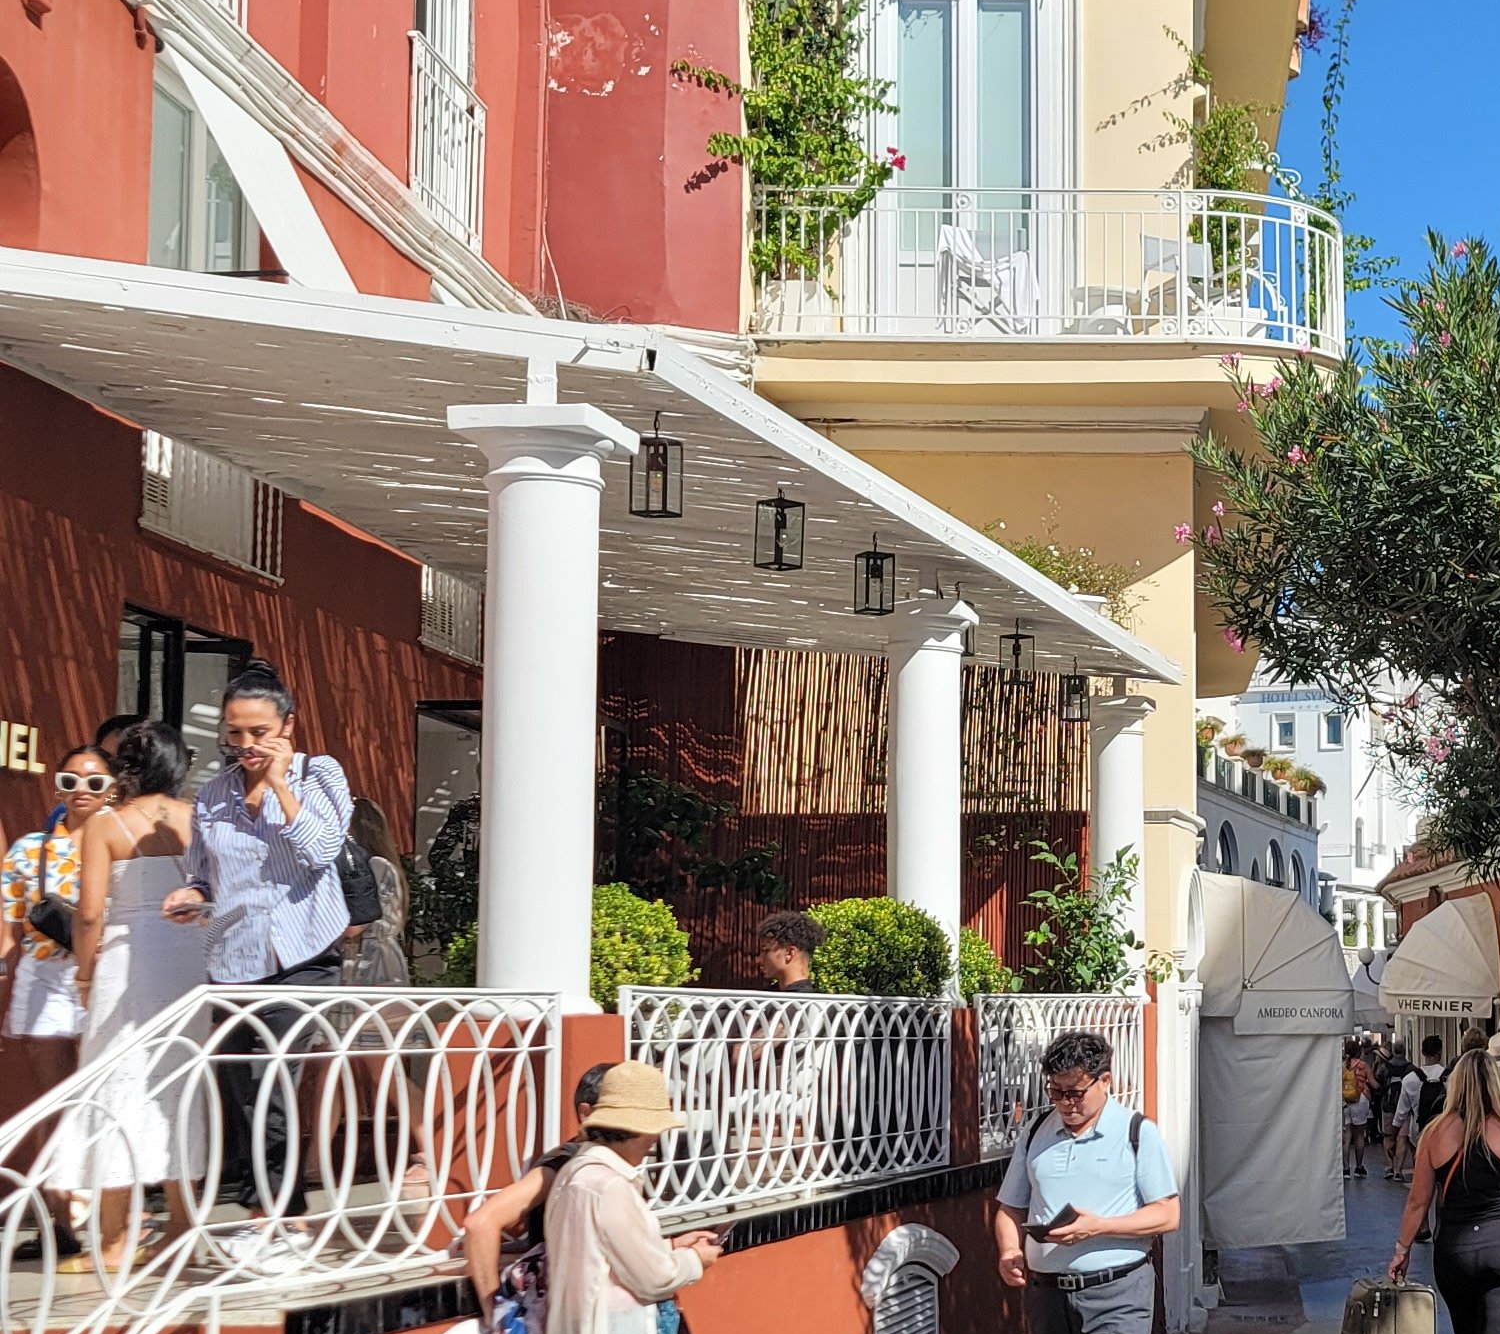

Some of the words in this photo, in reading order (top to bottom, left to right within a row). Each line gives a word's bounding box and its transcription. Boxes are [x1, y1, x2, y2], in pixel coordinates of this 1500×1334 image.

[1262, 692, 1301, 703] HOTEL
[1397, 998, 1474, 1013] VHERNIER
[1257, 1006, 1297, 1018] AMEDEO
[1299, 1006, 1344, 1019] CANFORA
